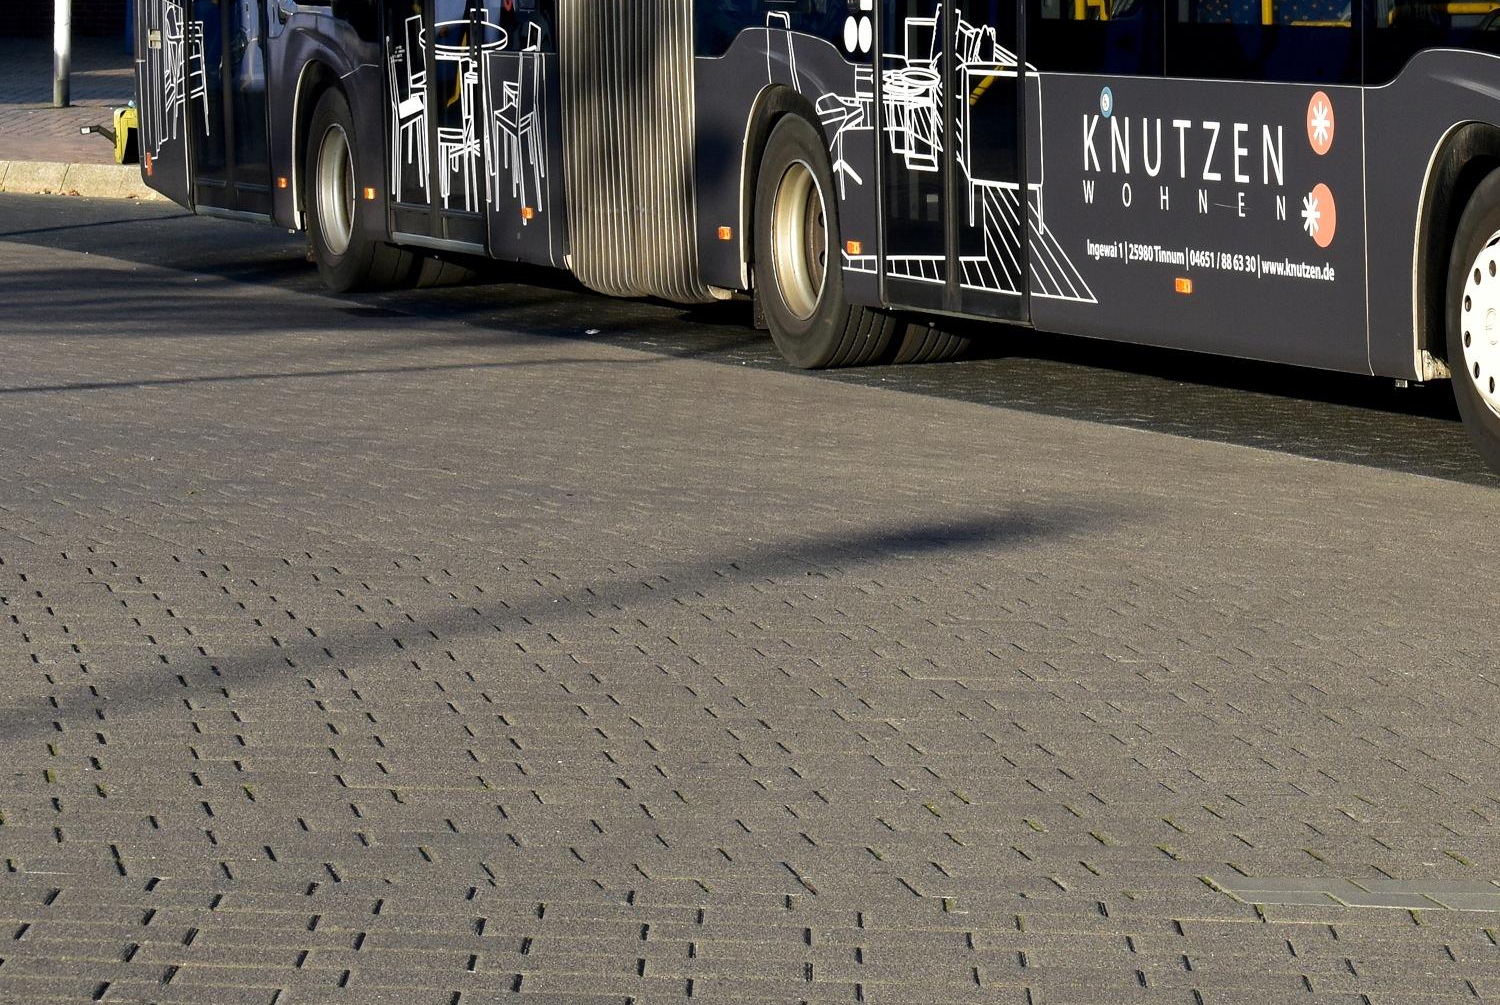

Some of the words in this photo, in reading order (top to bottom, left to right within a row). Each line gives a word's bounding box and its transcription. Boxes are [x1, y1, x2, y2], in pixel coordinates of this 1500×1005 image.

[1083, 113, 1284, 186] KNUTZEN
[1083, 180, 1286, 221] WOHNEN
[1087, 238, 1117, 260] Ingewai
[1119, 242, 1123, 258] 1
[1128, 243, 1153, 262] 25980
[1153, 245, 1185, 265] Tinnum
[1190, 249, 1215, 268] 04651
[1221, 252, 1232, 270] 88
[1233, 254, 1244, 272] 63
[1245, 255, 1256, 273] 30
[1261, 257, 1335, 281] www.knutzen.de
